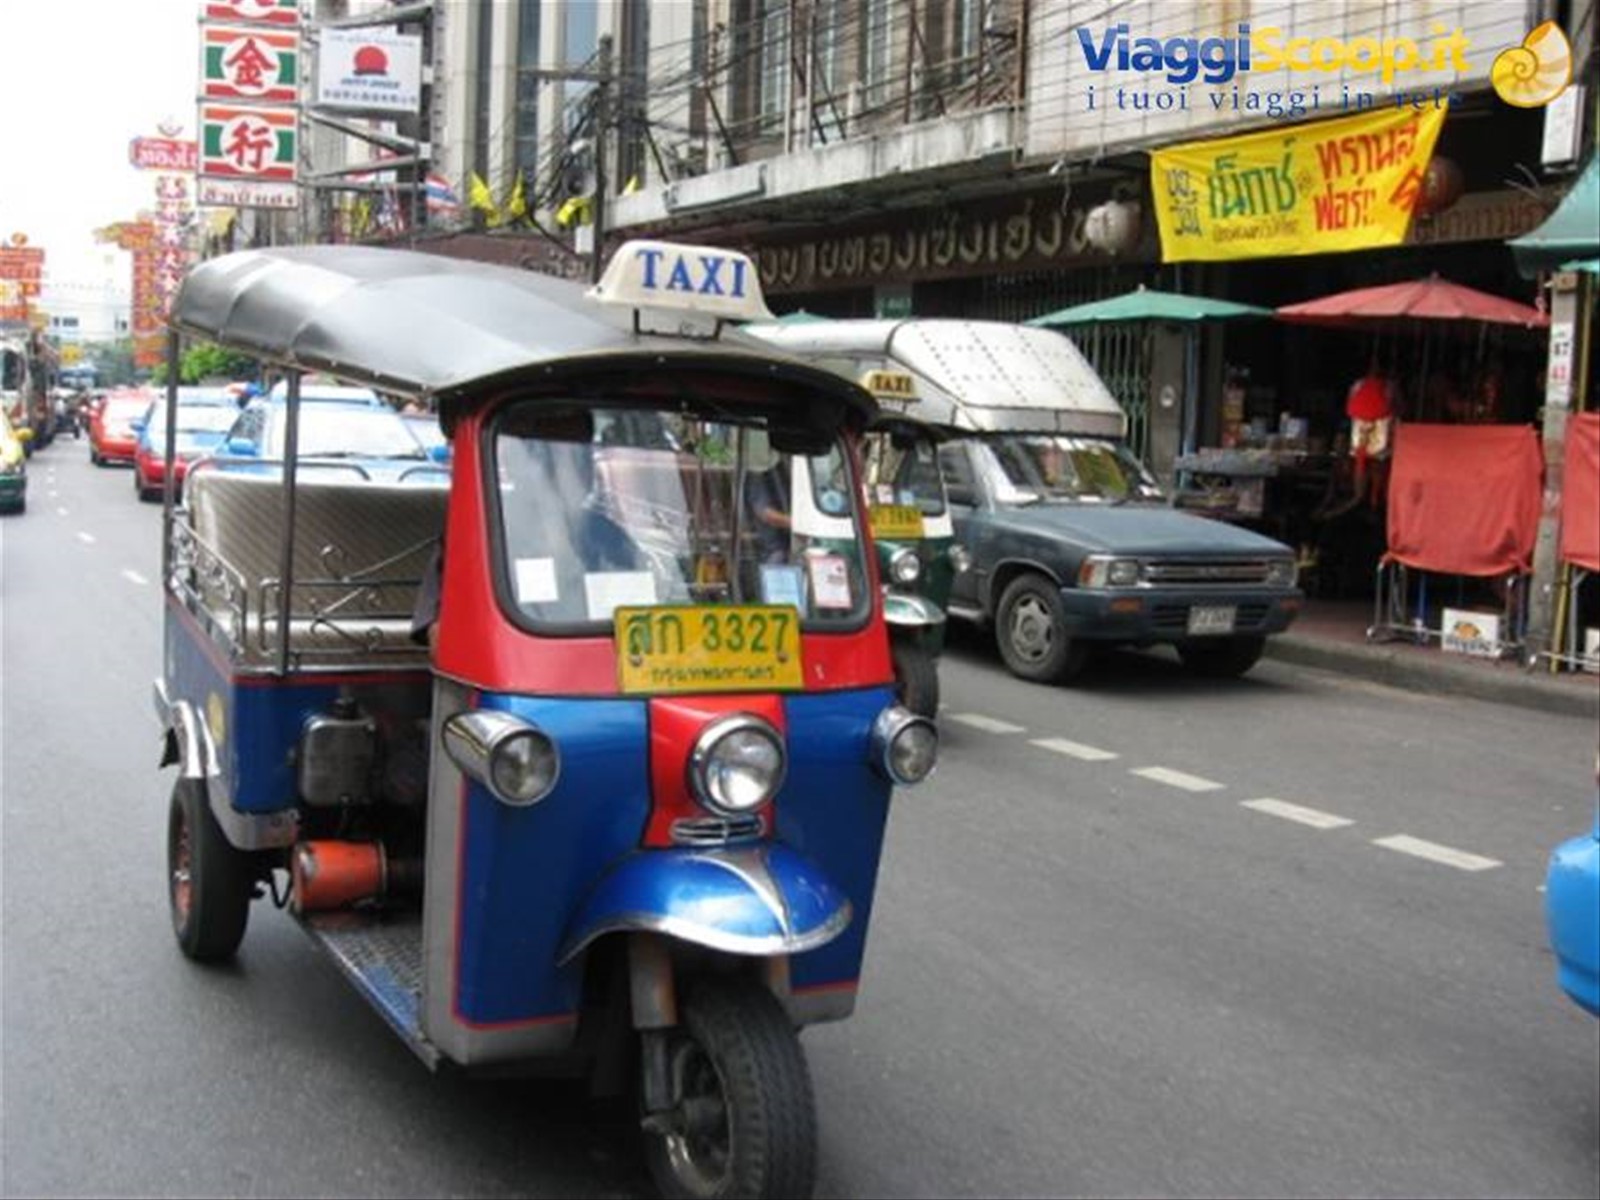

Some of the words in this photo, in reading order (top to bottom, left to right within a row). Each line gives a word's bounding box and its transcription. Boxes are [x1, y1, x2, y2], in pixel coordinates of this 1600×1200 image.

[225, 37, 276, 89] 金
[225, 120, 273, 169] 行
[635, 249, 746, 298] TAXI
[874, 374, 911, 392] TAXI
[702, 612, 789, 652] 3327
